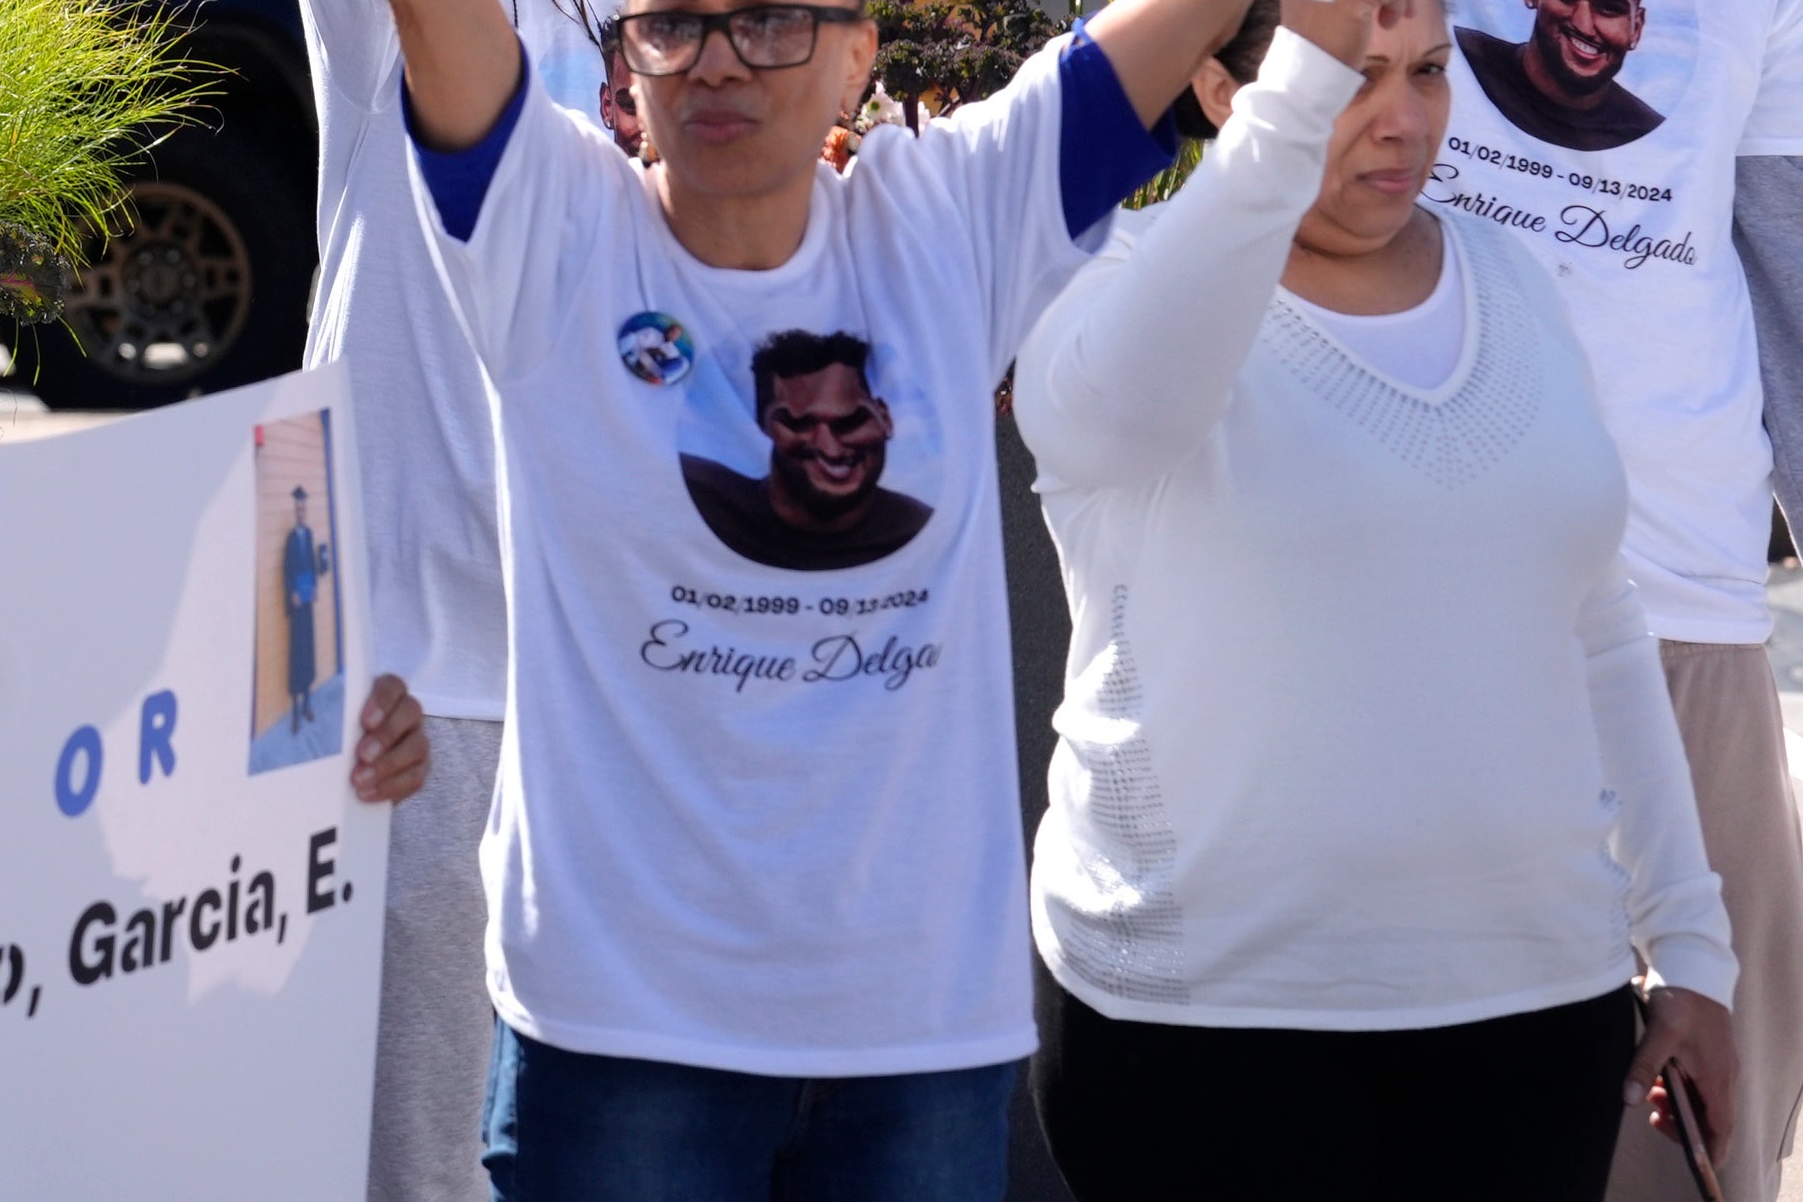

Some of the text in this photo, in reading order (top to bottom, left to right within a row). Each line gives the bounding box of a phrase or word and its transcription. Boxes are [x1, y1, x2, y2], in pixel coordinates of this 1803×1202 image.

[1448, 136, 1553, 179] 01/02/1999
[1568, 172, 1674, 203] 09/13/2024
[1421, 163, 1696, 270] Enrique Delgado
[640, 619, 797, 693] Enrique
[68, 854, 289, 985] Garcia,
[305, 827, 355, 915] E.
